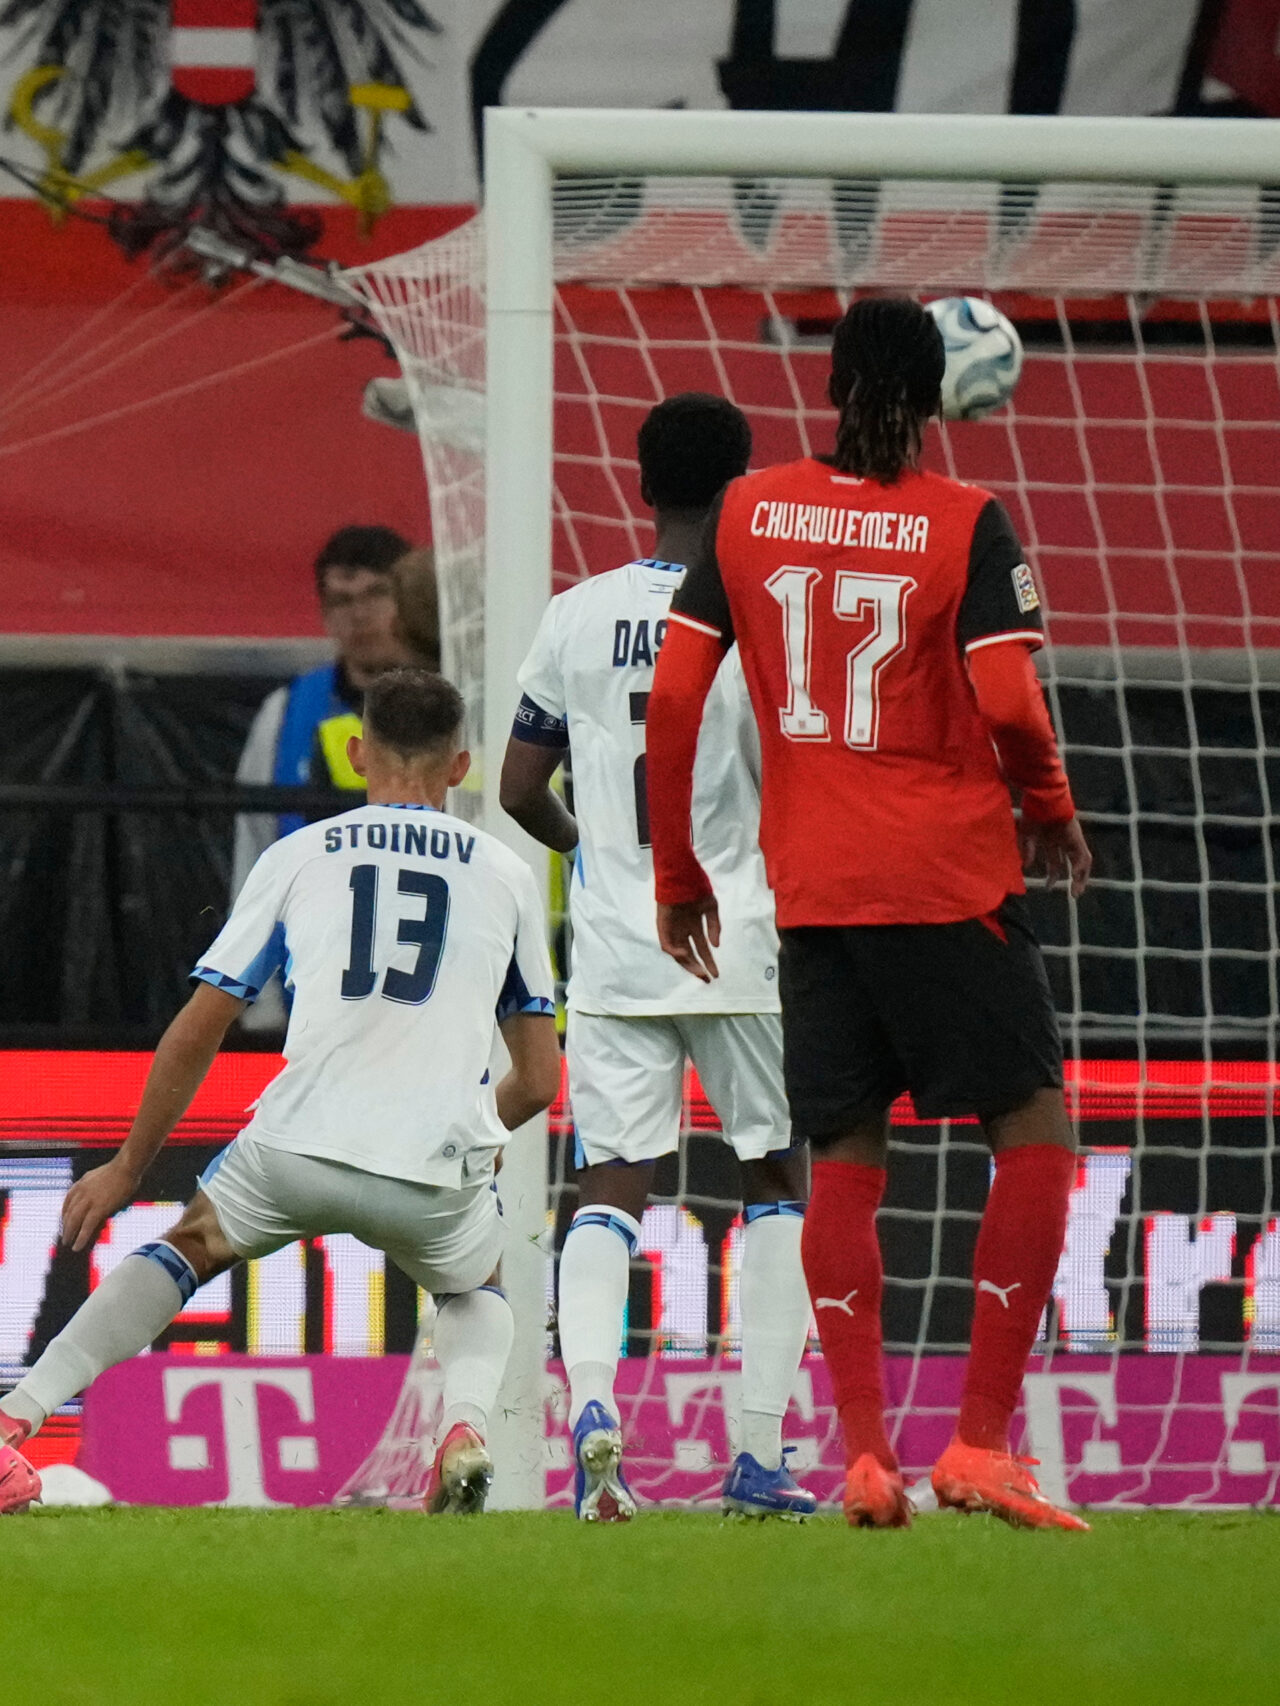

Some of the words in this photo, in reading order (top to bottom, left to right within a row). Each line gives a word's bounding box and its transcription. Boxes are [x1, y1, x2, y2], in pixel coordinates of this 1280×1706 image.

[750, 501, 929, 553] CHUKWUEMEKA
[764, 564, 918, 751] 17
[324, 823, 476, 865] STOINOV
[340, 864, 452, 1006] 13
